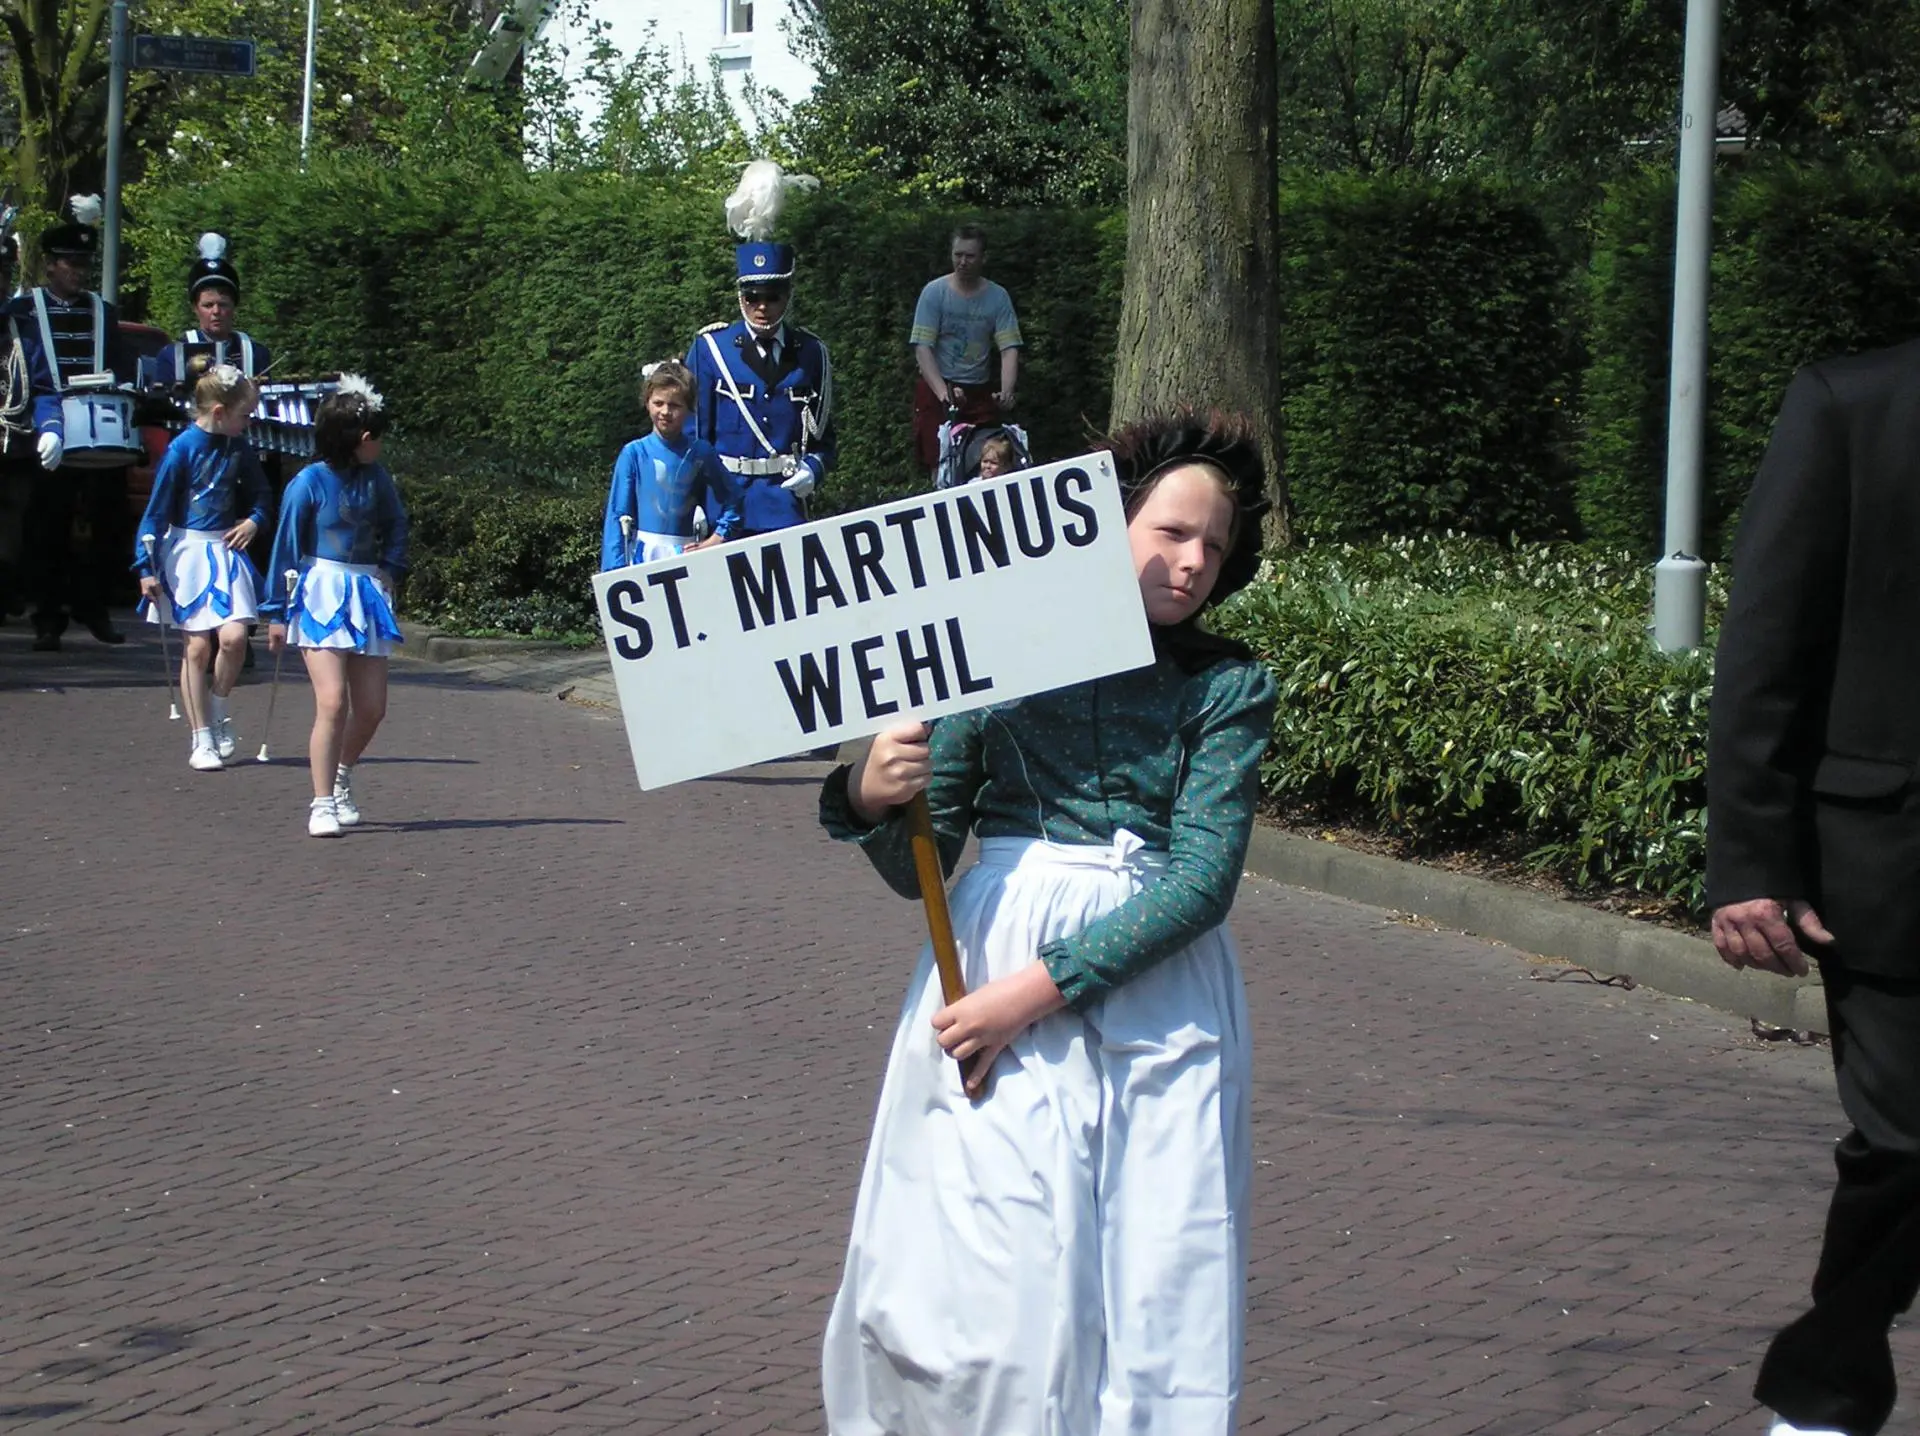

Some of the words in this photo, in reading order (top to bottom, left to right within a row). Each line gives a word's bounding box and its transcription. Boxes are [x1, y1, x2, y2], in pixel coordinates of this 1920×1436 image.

[606, 567, 708, 661] ST.
[726, 468, 1099, 632] MARTINUS
[775, 617, 994, 734] WEHL
